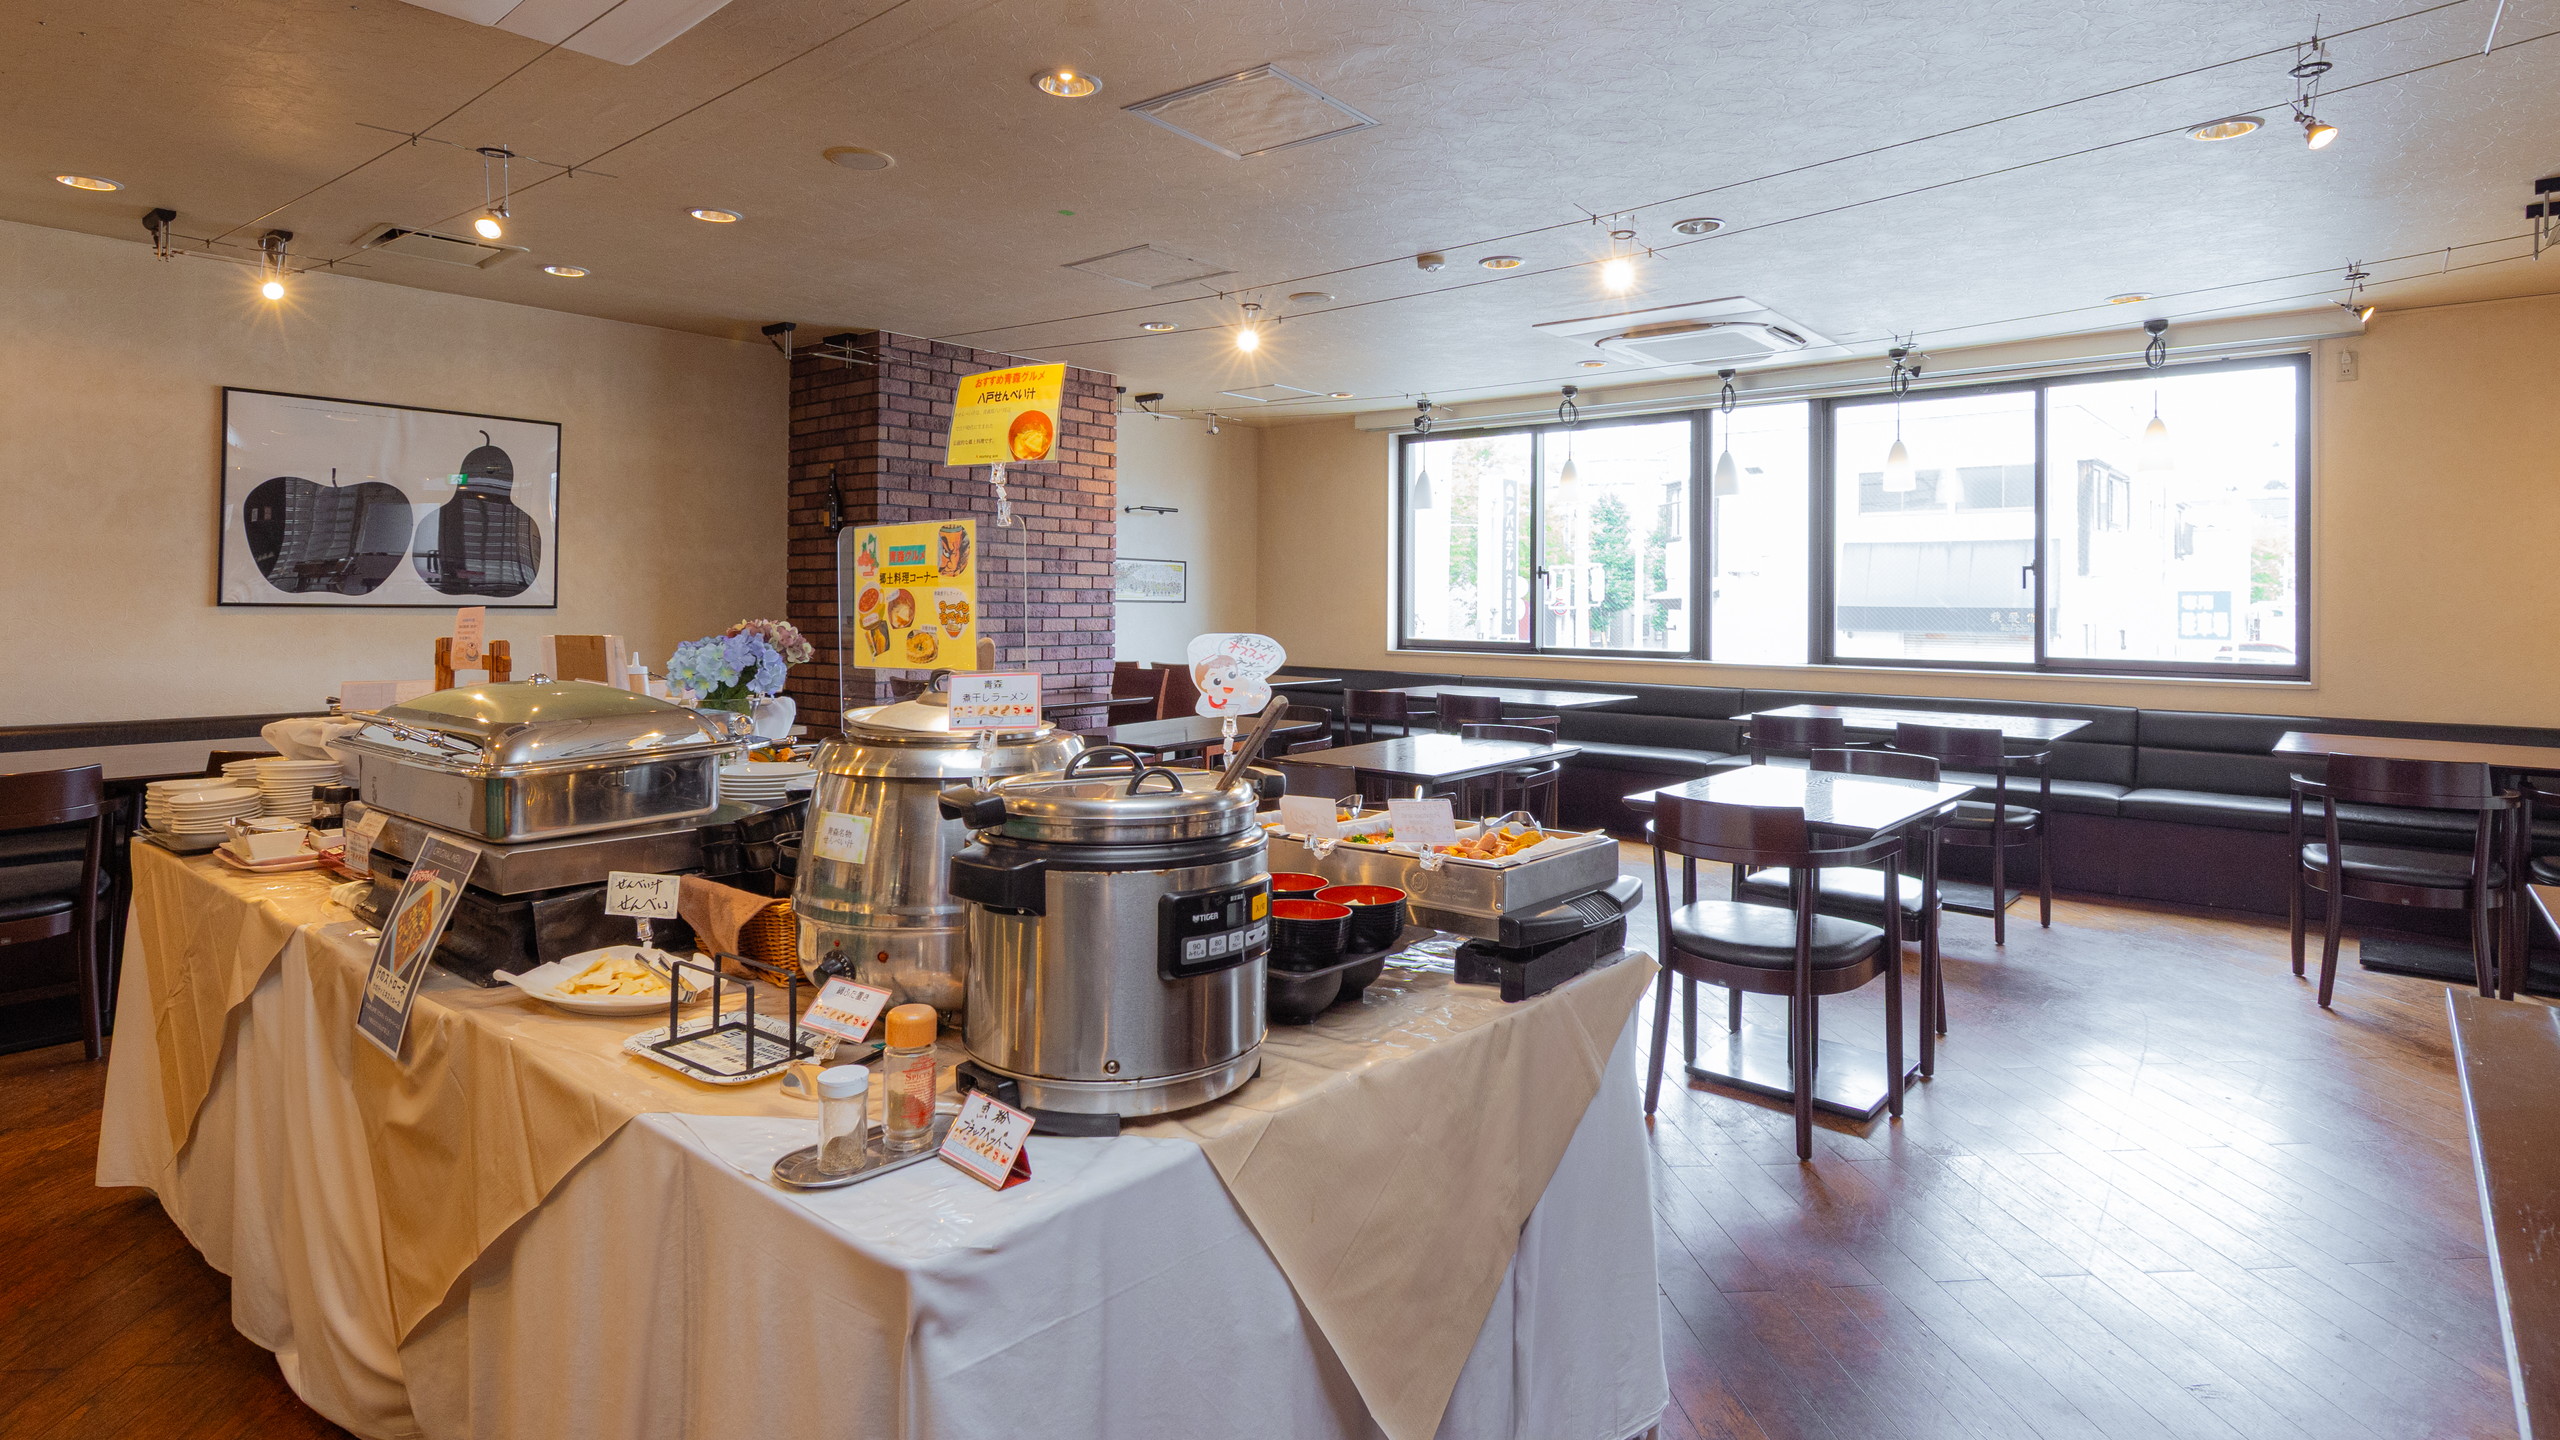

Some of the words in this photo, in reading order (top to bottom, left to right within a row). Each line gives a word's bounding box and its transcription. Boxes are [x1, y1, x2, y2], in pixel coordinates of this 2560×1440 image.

[975, 370, 1046, 389] おすすめ青森グルメ
[977, 387, 1036, 404] 八戸せんべい汁
[889, 550, 925, 563] 青森グルメ
[879, 571, 938, 585] 郷土料理コーナー
[984, 680, 1003, 689] 青森
[963, 692, 1029, 703] 煮干しラーメン
[828, 826, 853, 838] 青森名物
[823, 836, 854, 848] せんべい汁
[615, 878, 664, 895] せんべい汁
[616, 894, 669, 911] せんべい
[1200, 912, 1219, 922] TIGER
[836, 985, 870, 1002] 鍋ふた置き
[961, 1119, 1013, 1151] ブラックペッパー
